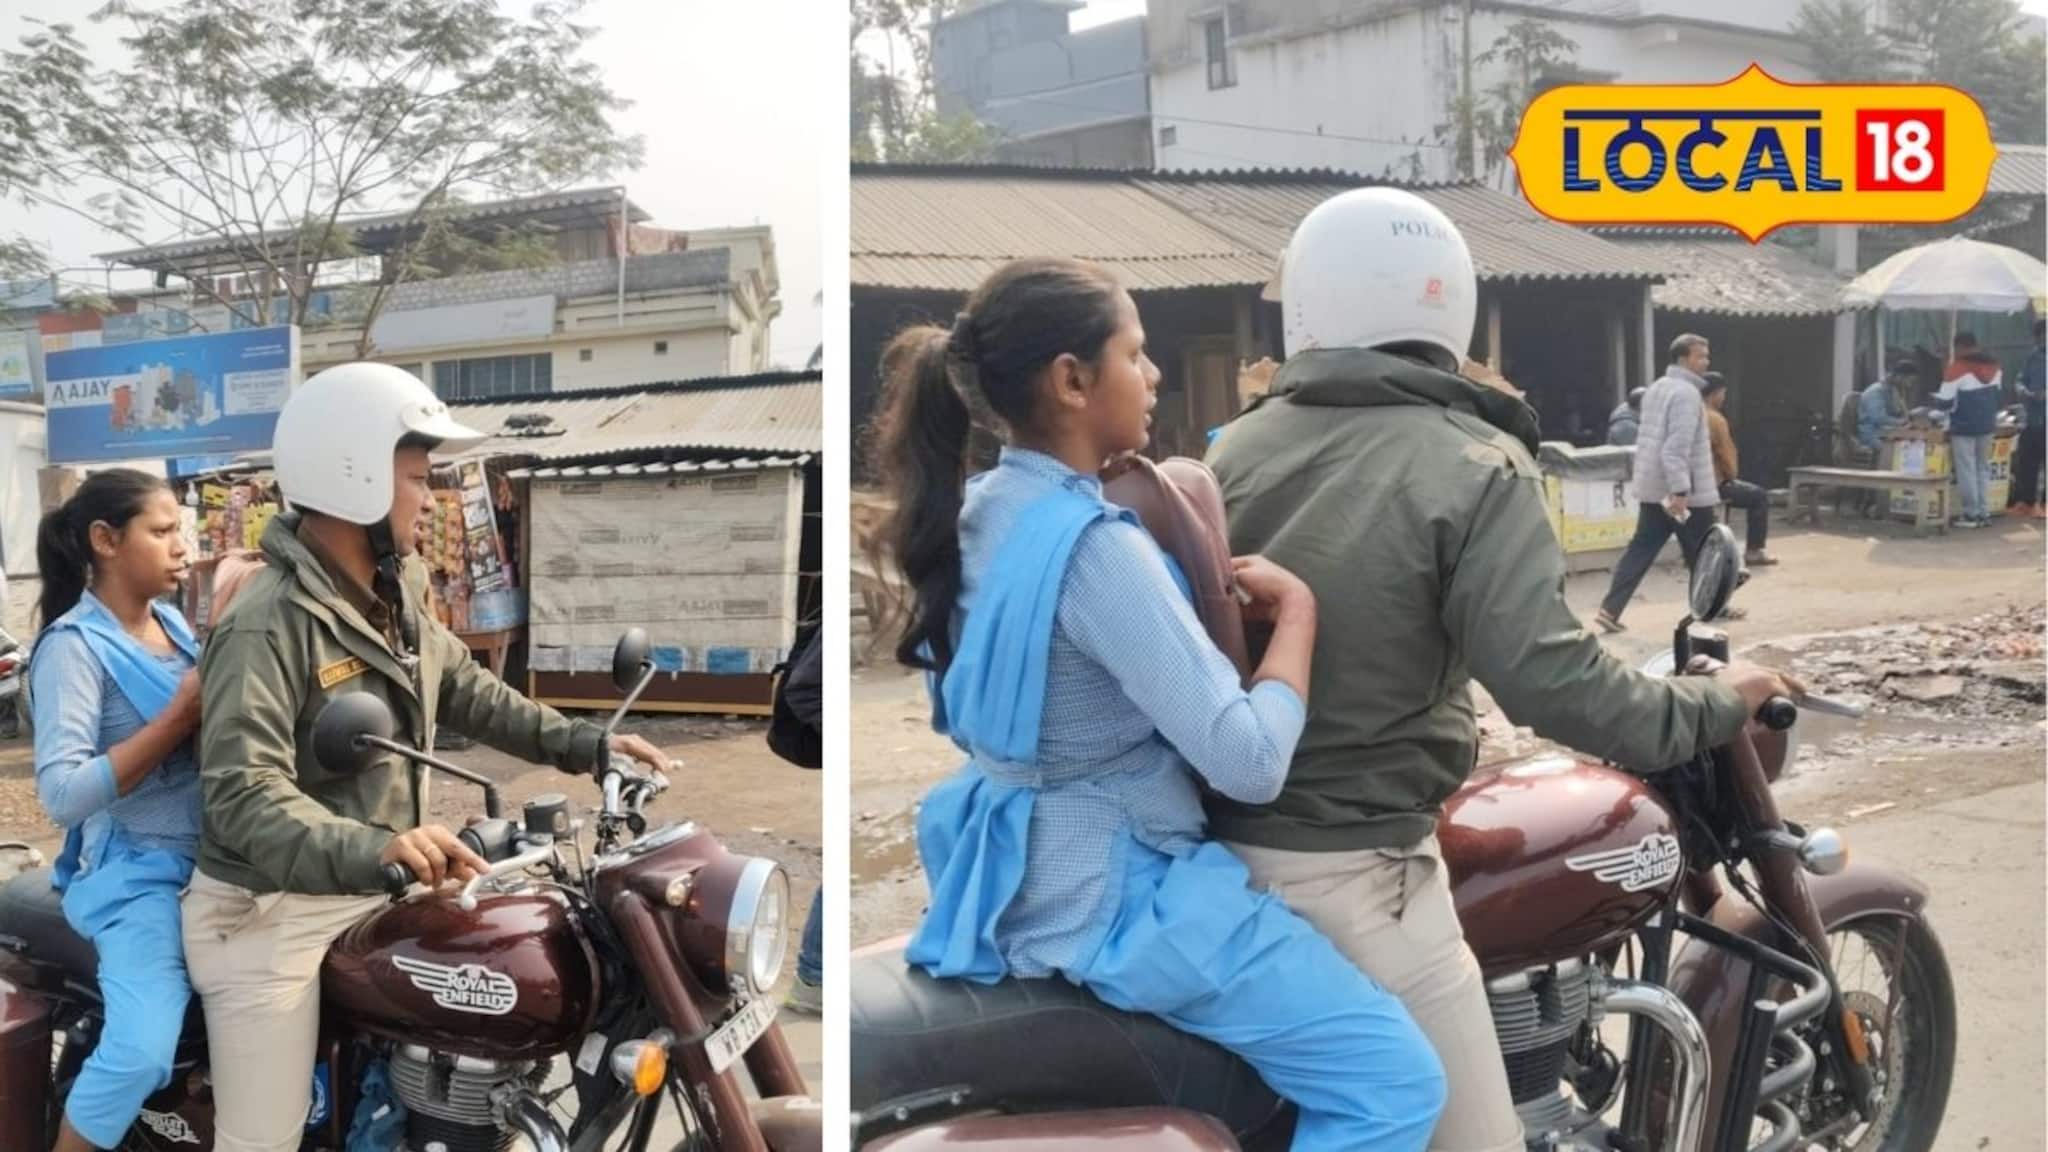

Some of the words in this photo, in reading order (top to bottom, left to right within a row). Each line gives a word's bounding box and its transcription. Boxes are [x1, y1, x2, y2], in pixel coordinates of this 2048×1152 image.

[67, 377, 112, 400] AJAY
[1631, 844, 1672, 867] ROYAL
[447, 972, 497, 992] ROYAL
[443, 989, 504, 1009] ENFIELD
